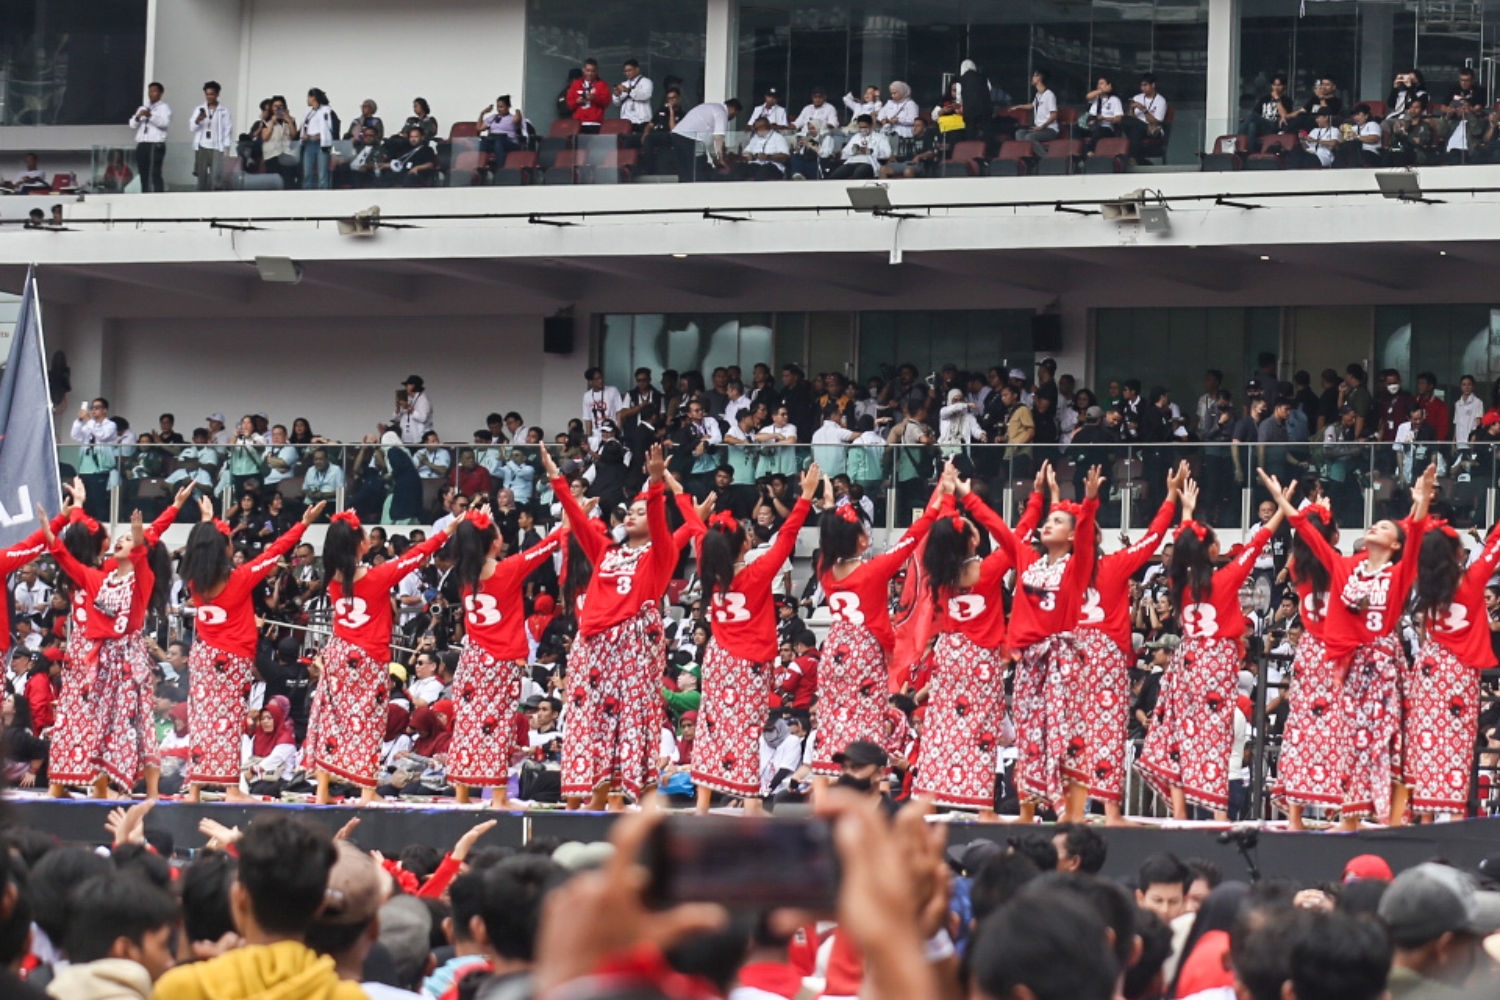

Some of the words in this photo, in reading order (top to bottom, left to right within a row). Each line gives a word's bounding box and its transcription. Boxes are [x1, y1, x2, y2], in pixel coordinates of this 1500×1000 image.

[616, 576, 632, 595] 3
[465, 593, 502, 626] 3
[1039, 592, 1056, 611] 3
[1183, 602, 1219, 637] 3
[1366, 611, 1384, 632] 3
